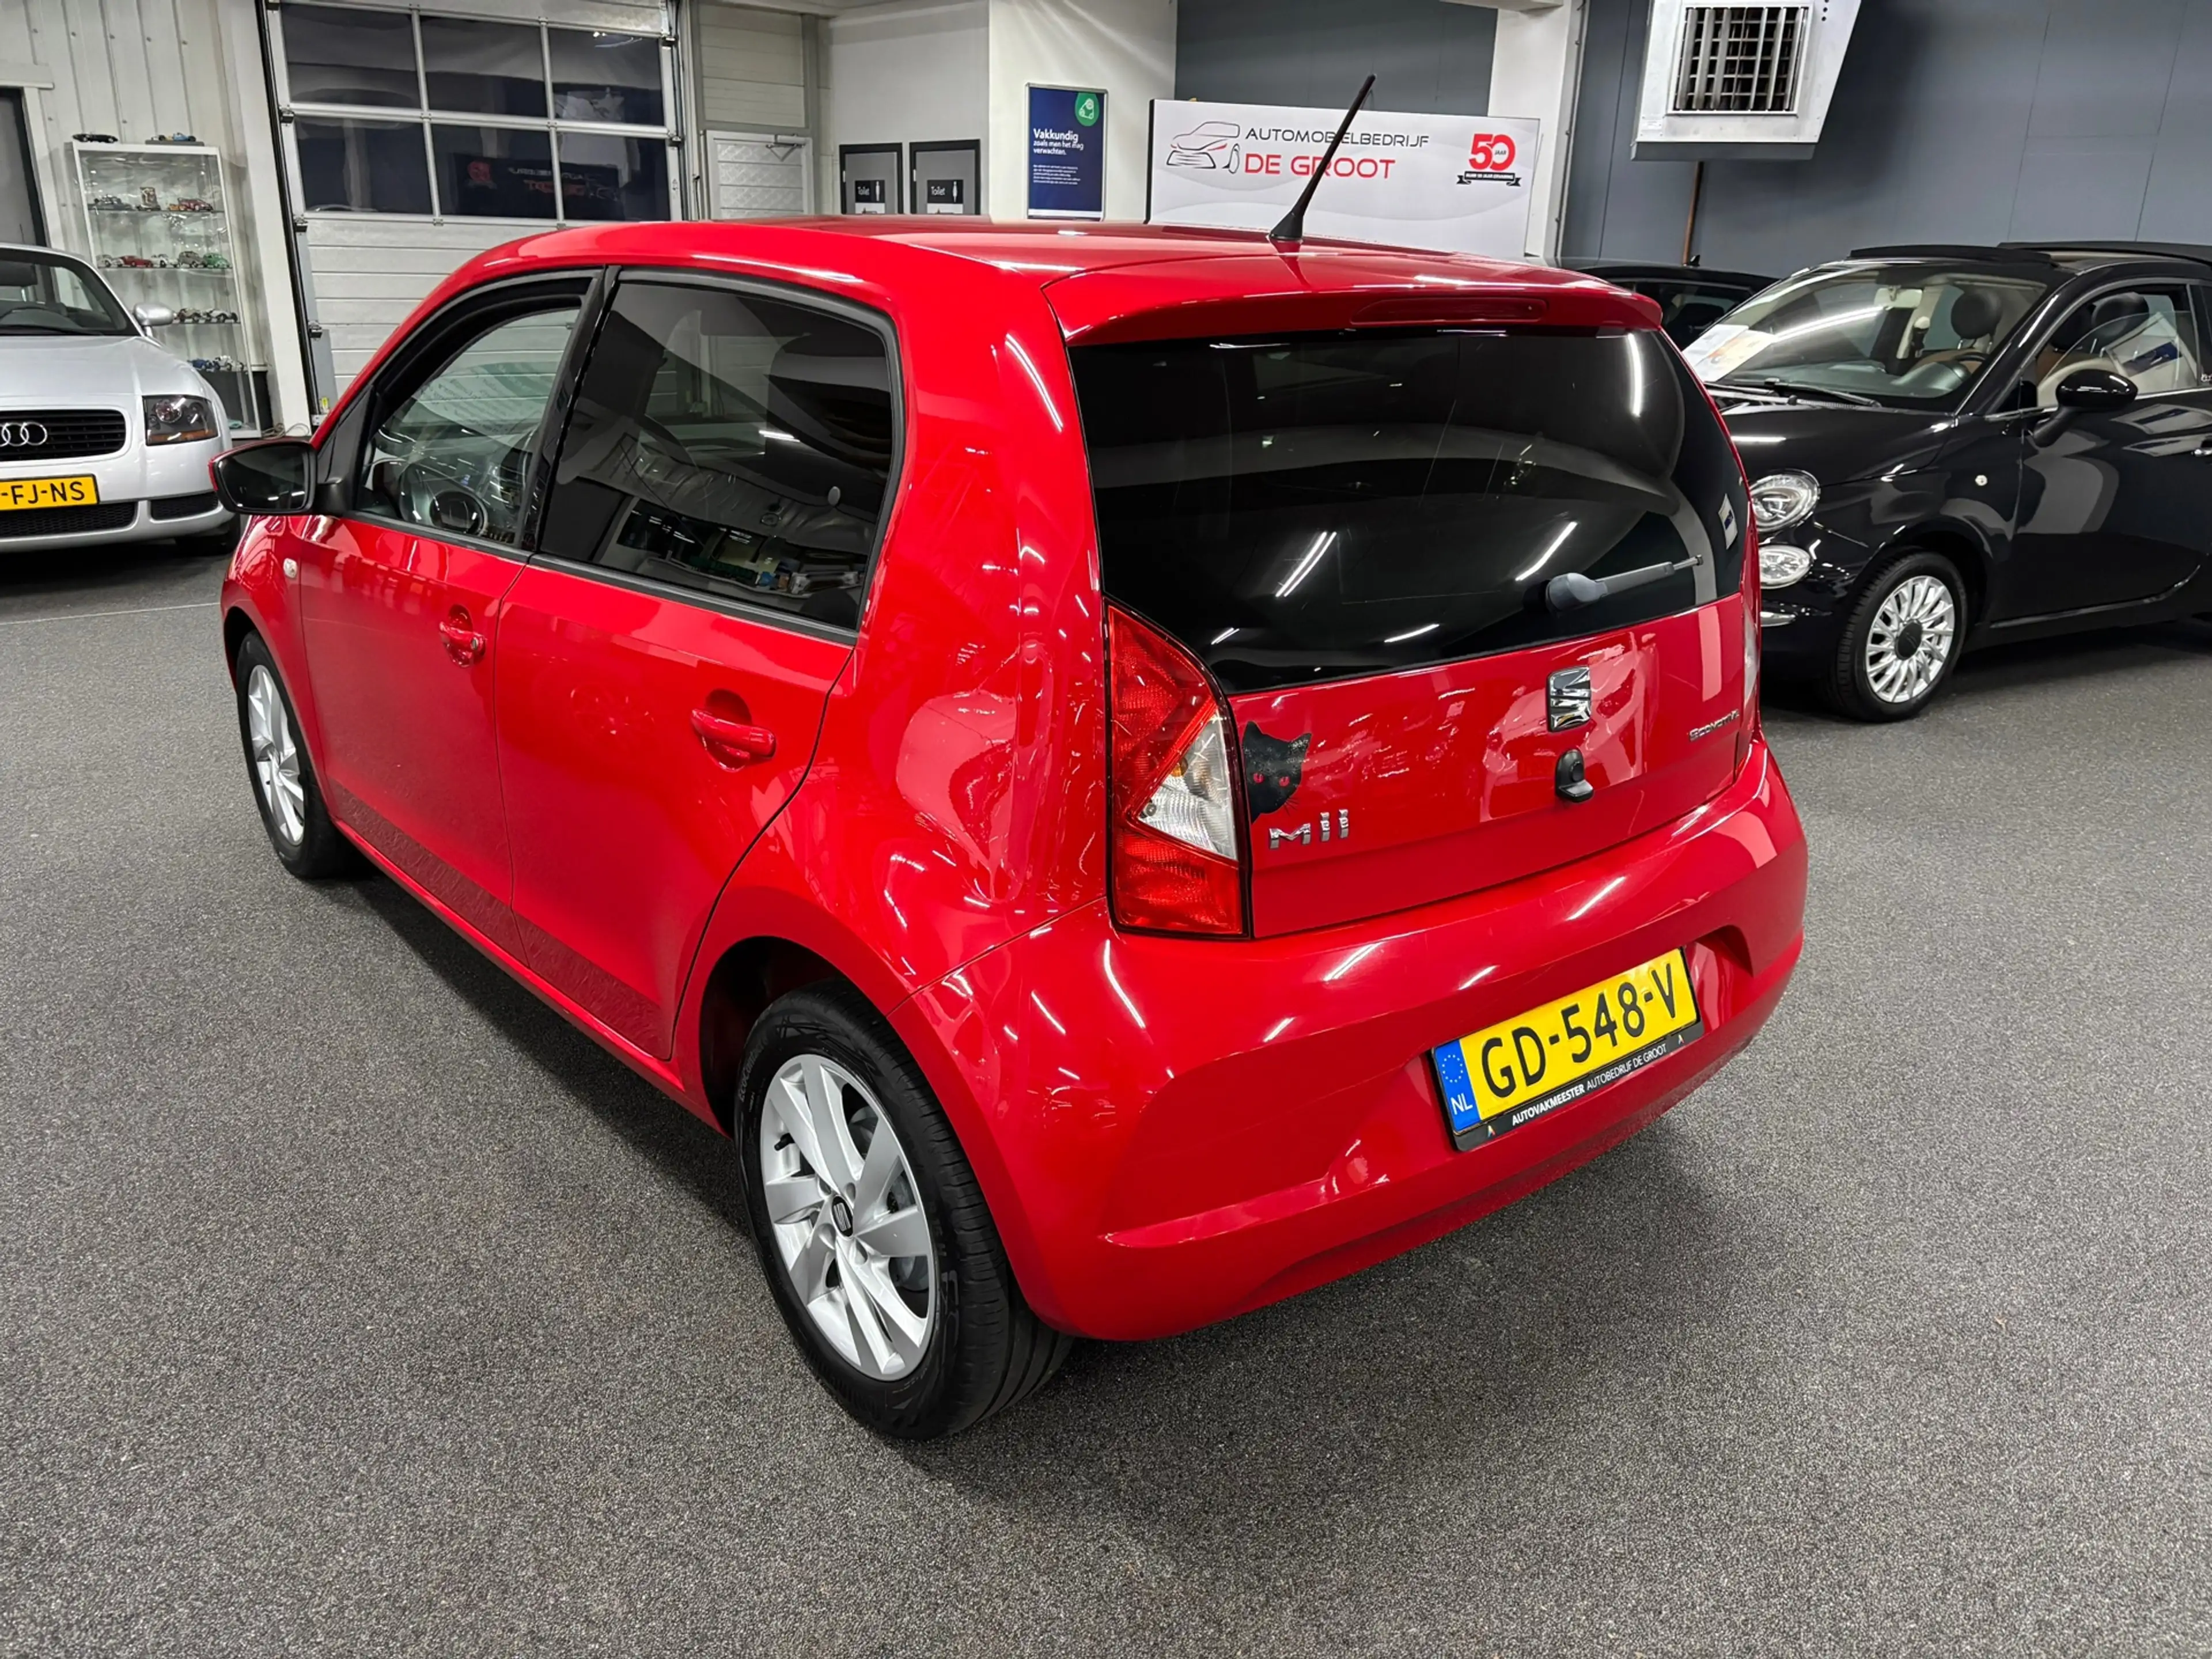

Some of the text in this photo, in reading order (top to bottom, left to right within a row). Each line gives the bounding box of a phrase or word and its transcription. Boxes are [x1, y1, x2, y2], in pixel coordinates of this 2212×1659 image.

[1033, 128, 1078, 144] Vakkundig
[1245, 153, 1281, 174] DE
[858, 186, 870, 196] Toilet
[931, 185, 945, 196] Toilet
[1482, 963, 1675, 1097] GD-548-V
[1513, 1043, 1666, 1126] AUTOVAKMEESTER AUTOBEDRIJF DE GROOT
[1450, 1093, 1473, 1115] NL
